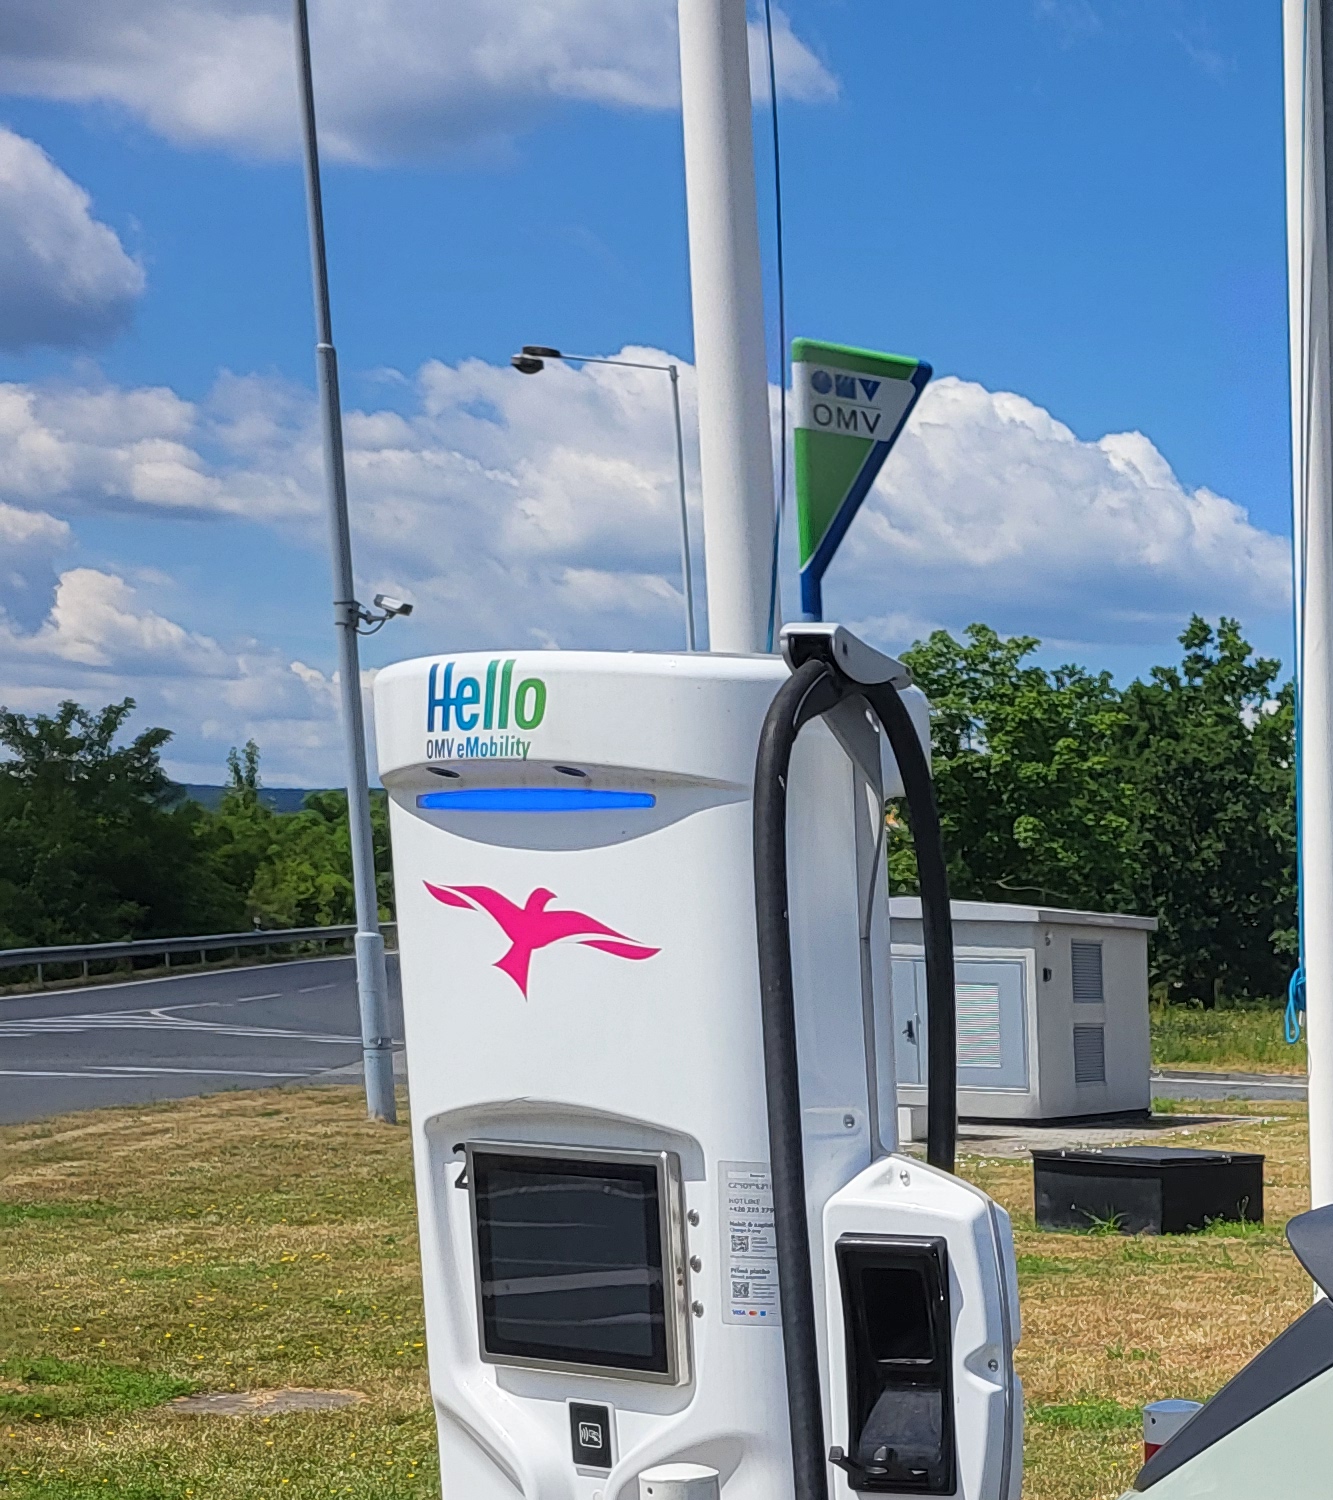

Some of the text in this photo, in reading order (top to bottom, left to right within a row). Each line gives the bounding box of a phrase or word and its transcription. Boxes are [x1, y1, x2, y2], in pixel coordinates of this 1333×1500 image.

[812, 403, 882, 434] OMV
[426, 658, 548, 733] Hello
[426, 735, 531, 762] OMV eMobility
